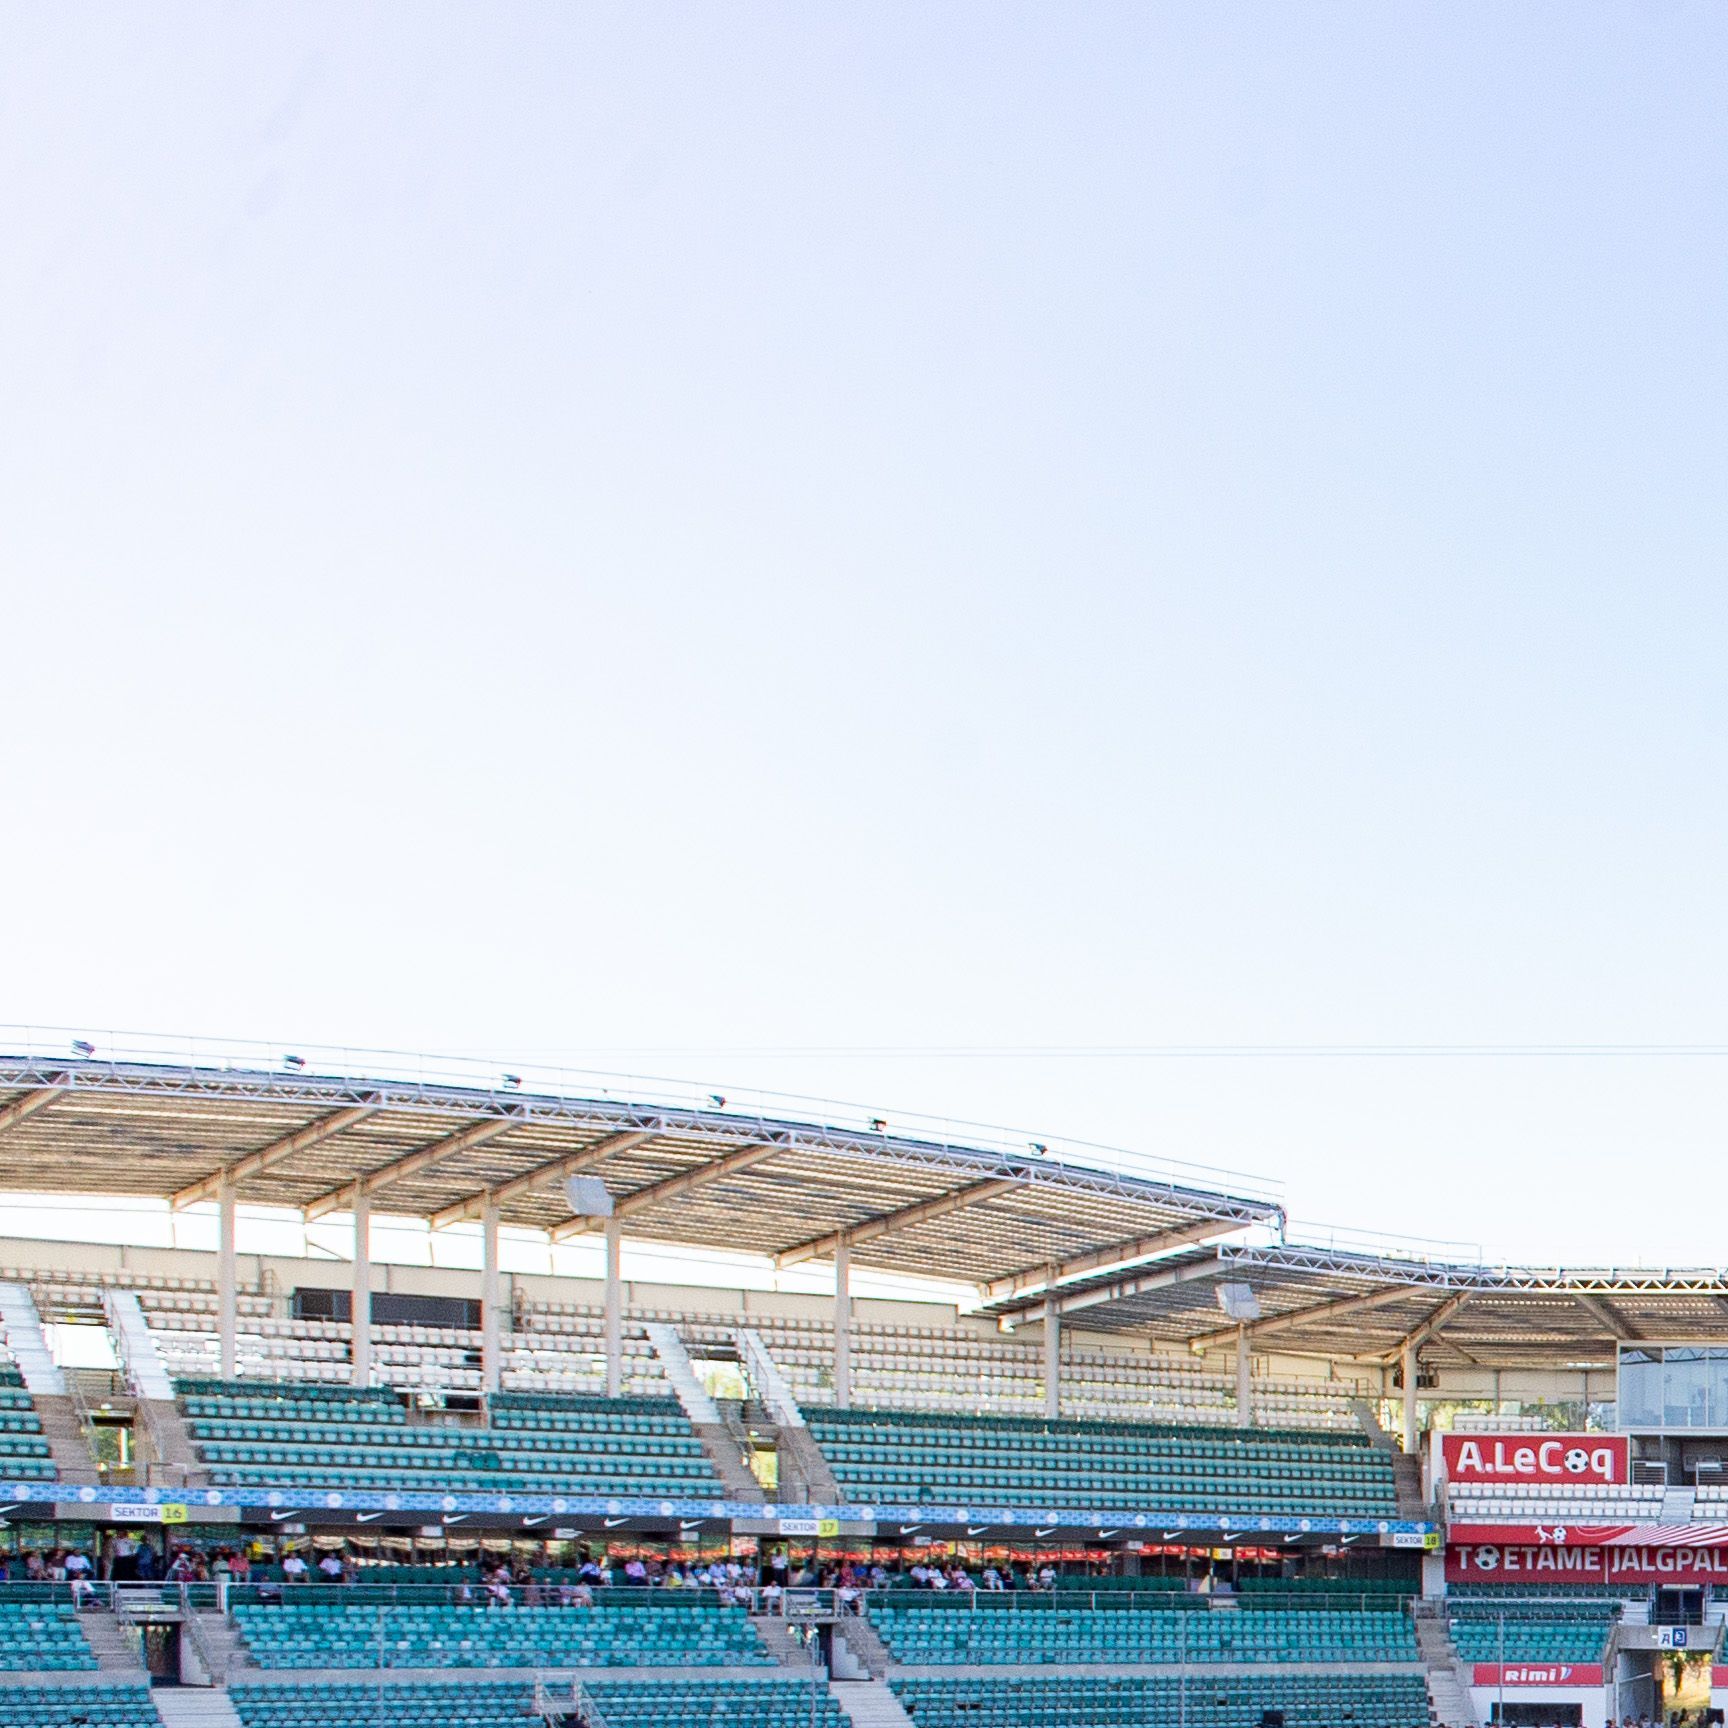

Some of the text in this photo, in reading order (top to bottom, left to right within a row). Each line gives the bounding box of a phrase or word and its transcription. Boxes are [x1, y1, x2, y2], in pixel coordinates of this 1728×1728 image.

[114, 1506, 183, 1519] SEKTOR 16
[782, 1521, 835, 1533] SEKTOR 17
[1395, 1535, 1423, 1545] SEKTOR
